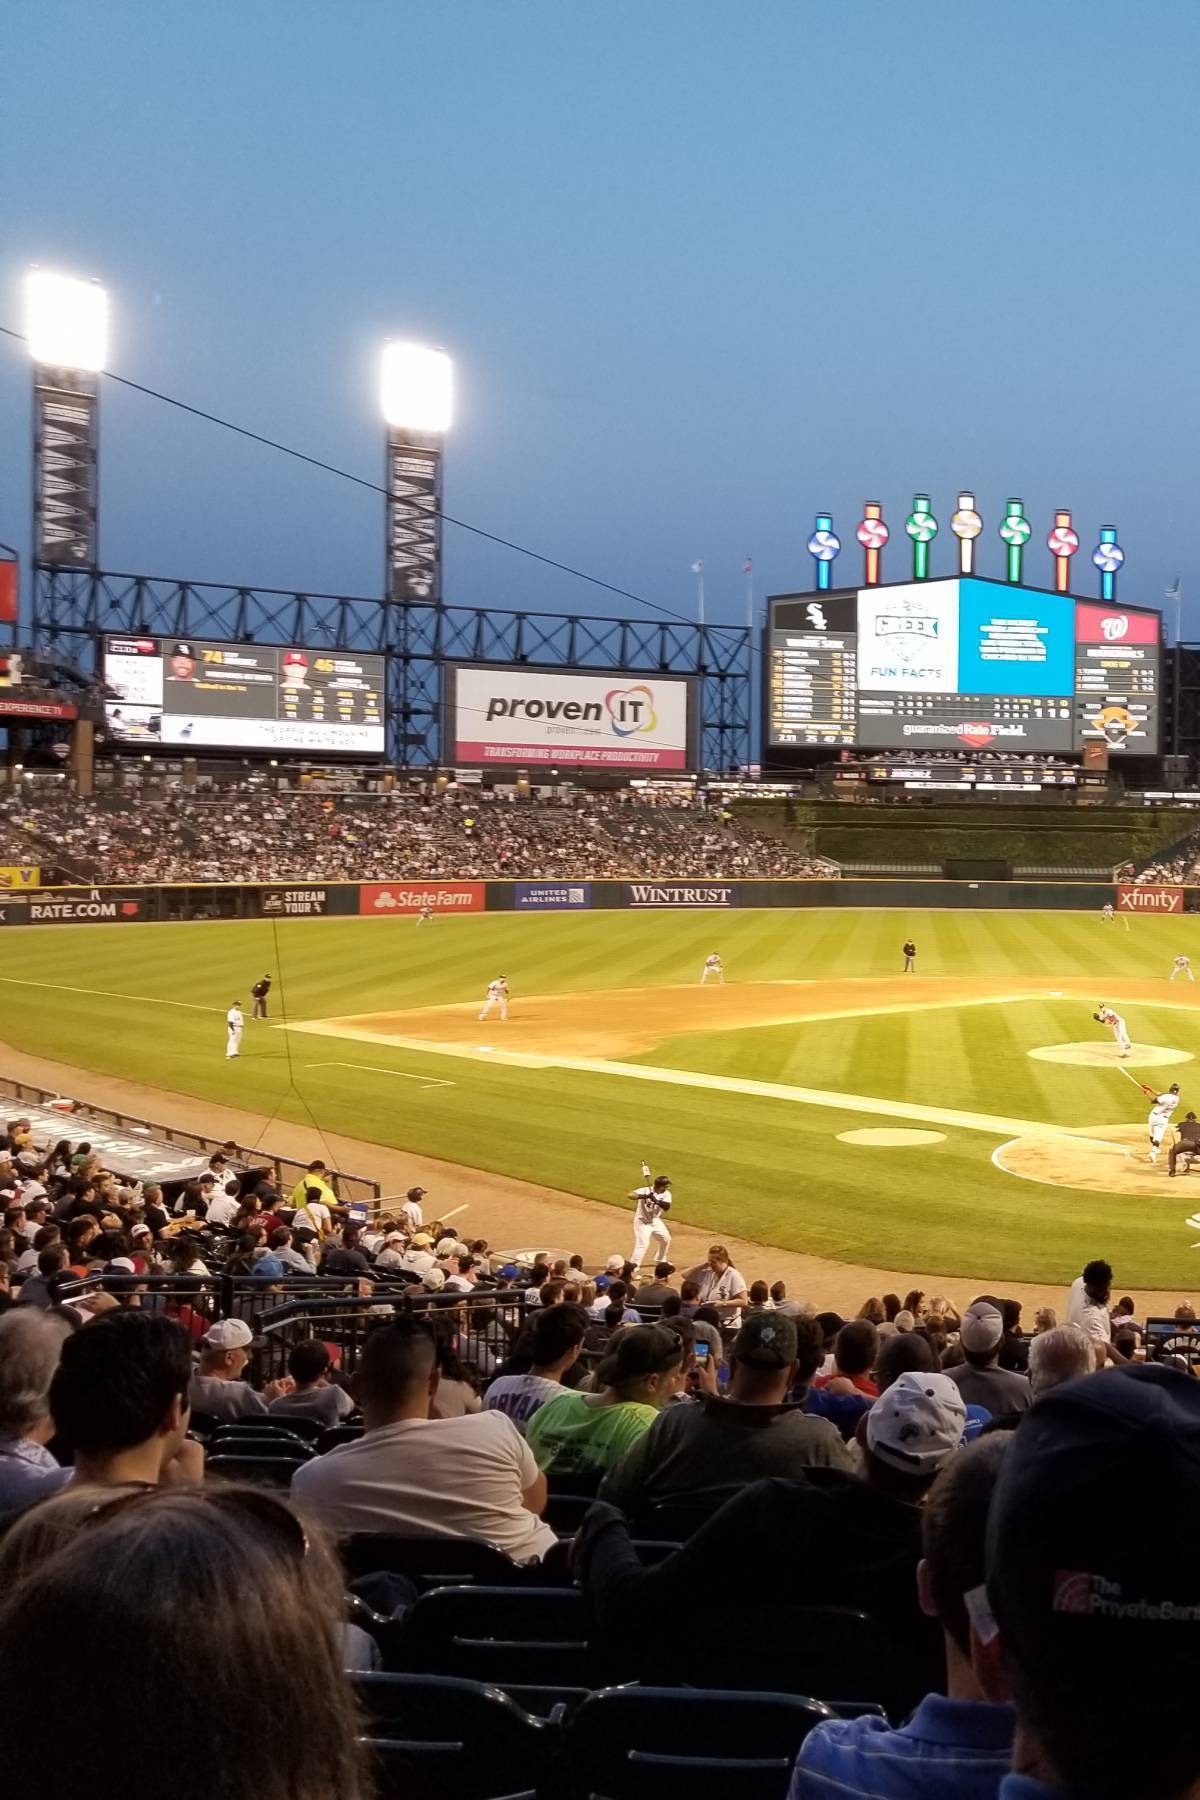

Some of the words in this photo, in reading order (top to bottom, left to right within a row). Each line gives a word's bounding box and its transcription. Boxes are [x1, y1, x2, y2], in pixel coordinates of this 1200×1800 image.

[871, 668, 897, 677] FUN
[902, 668, 942, 678] FACTS
[486, 697, 603, 721] proven
[619, 700, 644, 723] IT
[484, 746, 549, 759] TRANSFORMING
[550, 749, 600, 761] WORKPLACE
[601, 751, 660, 763] PRODUCTIVITY
[284, 891, 326, 902] STREAM
[630, 885, 732, 902] WINTRUST
[1121, 888, 1180, 911] xfinity
[31, 903, 117, 919] RATE.COM
[284, 902, 311, 913] YOUR
[1093, 1574, 1122, 1595] The
